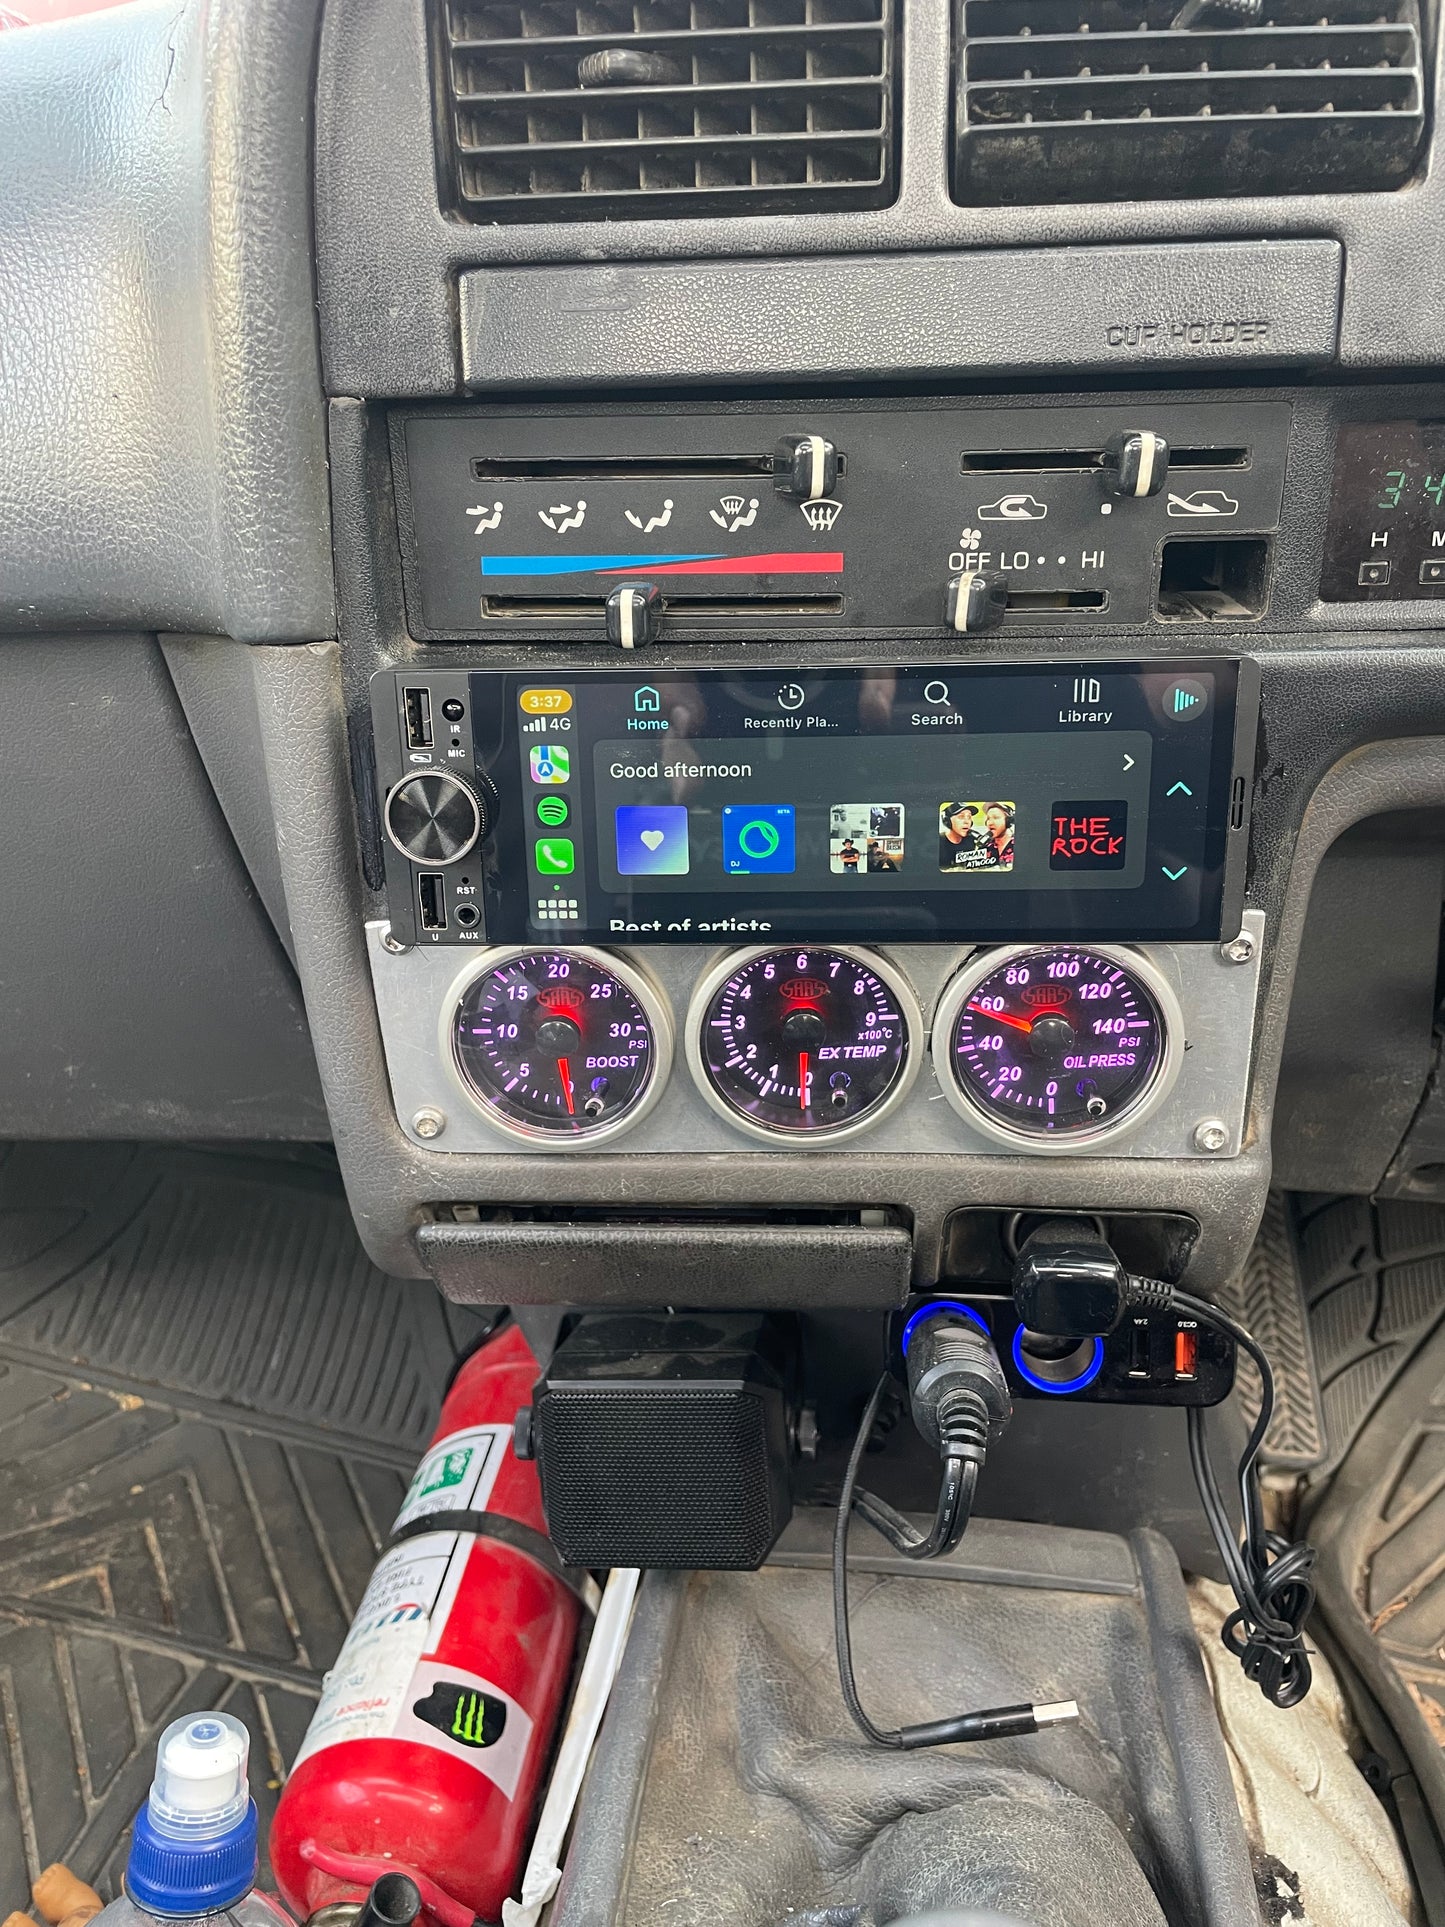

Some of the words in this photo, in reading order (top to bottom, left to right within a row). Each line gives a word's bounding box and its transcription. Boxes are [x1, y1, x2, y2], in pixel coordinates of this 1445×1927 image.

[1371, 531, 1388, 548] H
[949, 552, 990, 571] OFF
[1001, 552, 1029, 570] LO
[1082, 550, 1105, 569] HI
[529, 695, 562, 709] 3:37
[550, 717, 572, 731] 4G
[627, 717, 669, 731] Home
[744, 716, 802, 731] Recently
[806, 715, 839, 728] Pla...
[911, 711, 964, 726] Search
[1059, 709, 1113, 725] Library
[450, 725, 461, 733] IR
[447, 749, 466, 758] MIC
[610, 762, 660, 779] Good
[663, 762, 752, 778] afternoon
[1053, 816, 1111, 837] THE
[1052, 836, 1124, 858] ROCK
[957, 849, 987, 862] ROMAN
[966, 856, 997, 868] ATWOOD
[456, 886, 475, 895] RST
[432, 933, 439, 941] U
[459, 931, 479, 940] AUX
[796, 954, 808, 969] 6
[548, 964, 570, 978] 20
[763, 963, 775, 979] 5
[829, 962, 841, 978] 7
[1005, 968, 1030, 985] 80
[1046, 961, 1080, 979] 100
[507, 985, 528, 1000] 15
[590, 983, 612, 999] 25
[740, 984, 751, 999] 4
[853, 980, 865, 995] 8
[1078, 982, 1112, 1000] 120
[980, 996, 1005, 1011] 60
[734, 1015, 746, 1029] 3
[865, 1012, 876, 1027] 9
[1092, 1018, 1126, 1035] 140
[496, 1023, 518, 1038] 10
[609, 1022, 631, 1038] 30
[628, 1039, 648, 1049] PSI
[978, 1035, 1003, 1050] 40
[1118, 1036, 1141, 1047] PSI
[746, 1044, 757, 1058] 2
[818, 1047, 842, 1060] EX
[842, 1045, 887, 1059] TEMP
[586, 1055, 639, 1069] BOOST
[1063, 1055, 1087, 1069] OIL
[1088, 1052, 1136, 1068] PRESS
[519, 1063, 530, 1077] 5
[769, 1064, 779, 1079] 1
[999, 1066, 1022, 1081] 20
[1046, 1081, 1058, 1096] 0
